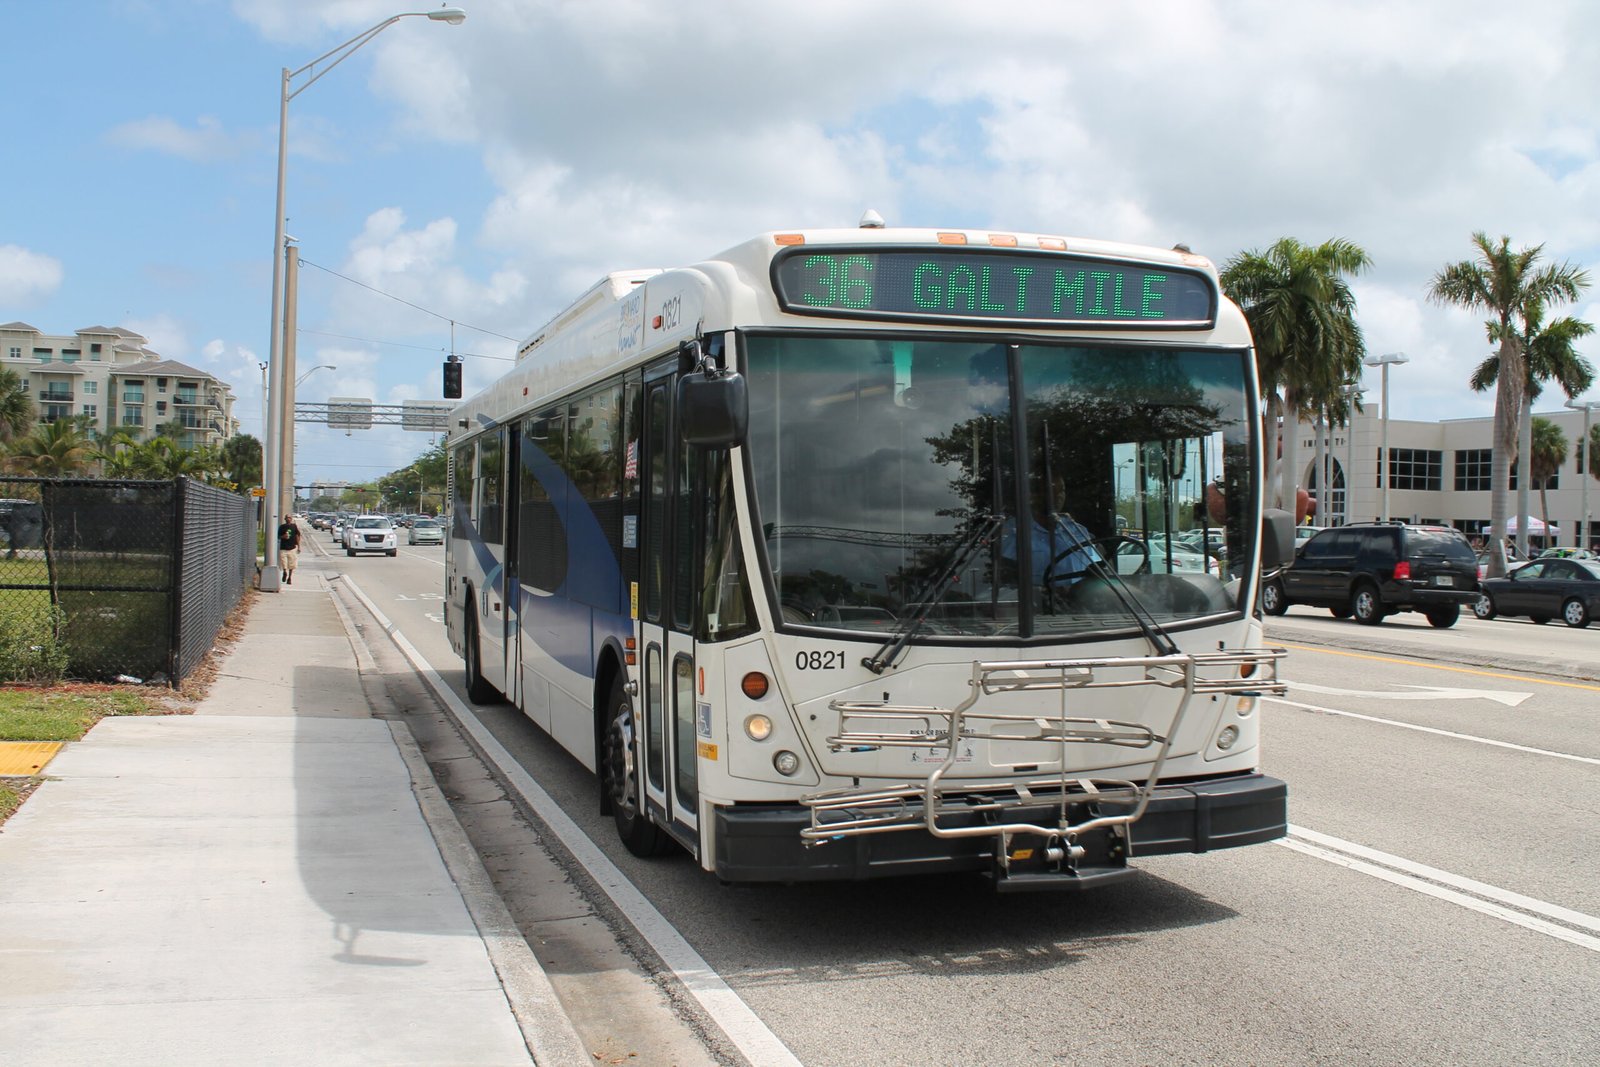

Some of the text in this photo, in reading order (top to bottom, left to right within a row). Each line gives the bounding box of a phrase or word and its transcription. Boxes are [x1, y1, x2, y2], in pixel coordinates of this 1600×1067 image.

[804, 254, 1167, 318] 36 GALT MILE
[662, 294, 681, 332] 0821
[795, 650, 845, 671] 0821
